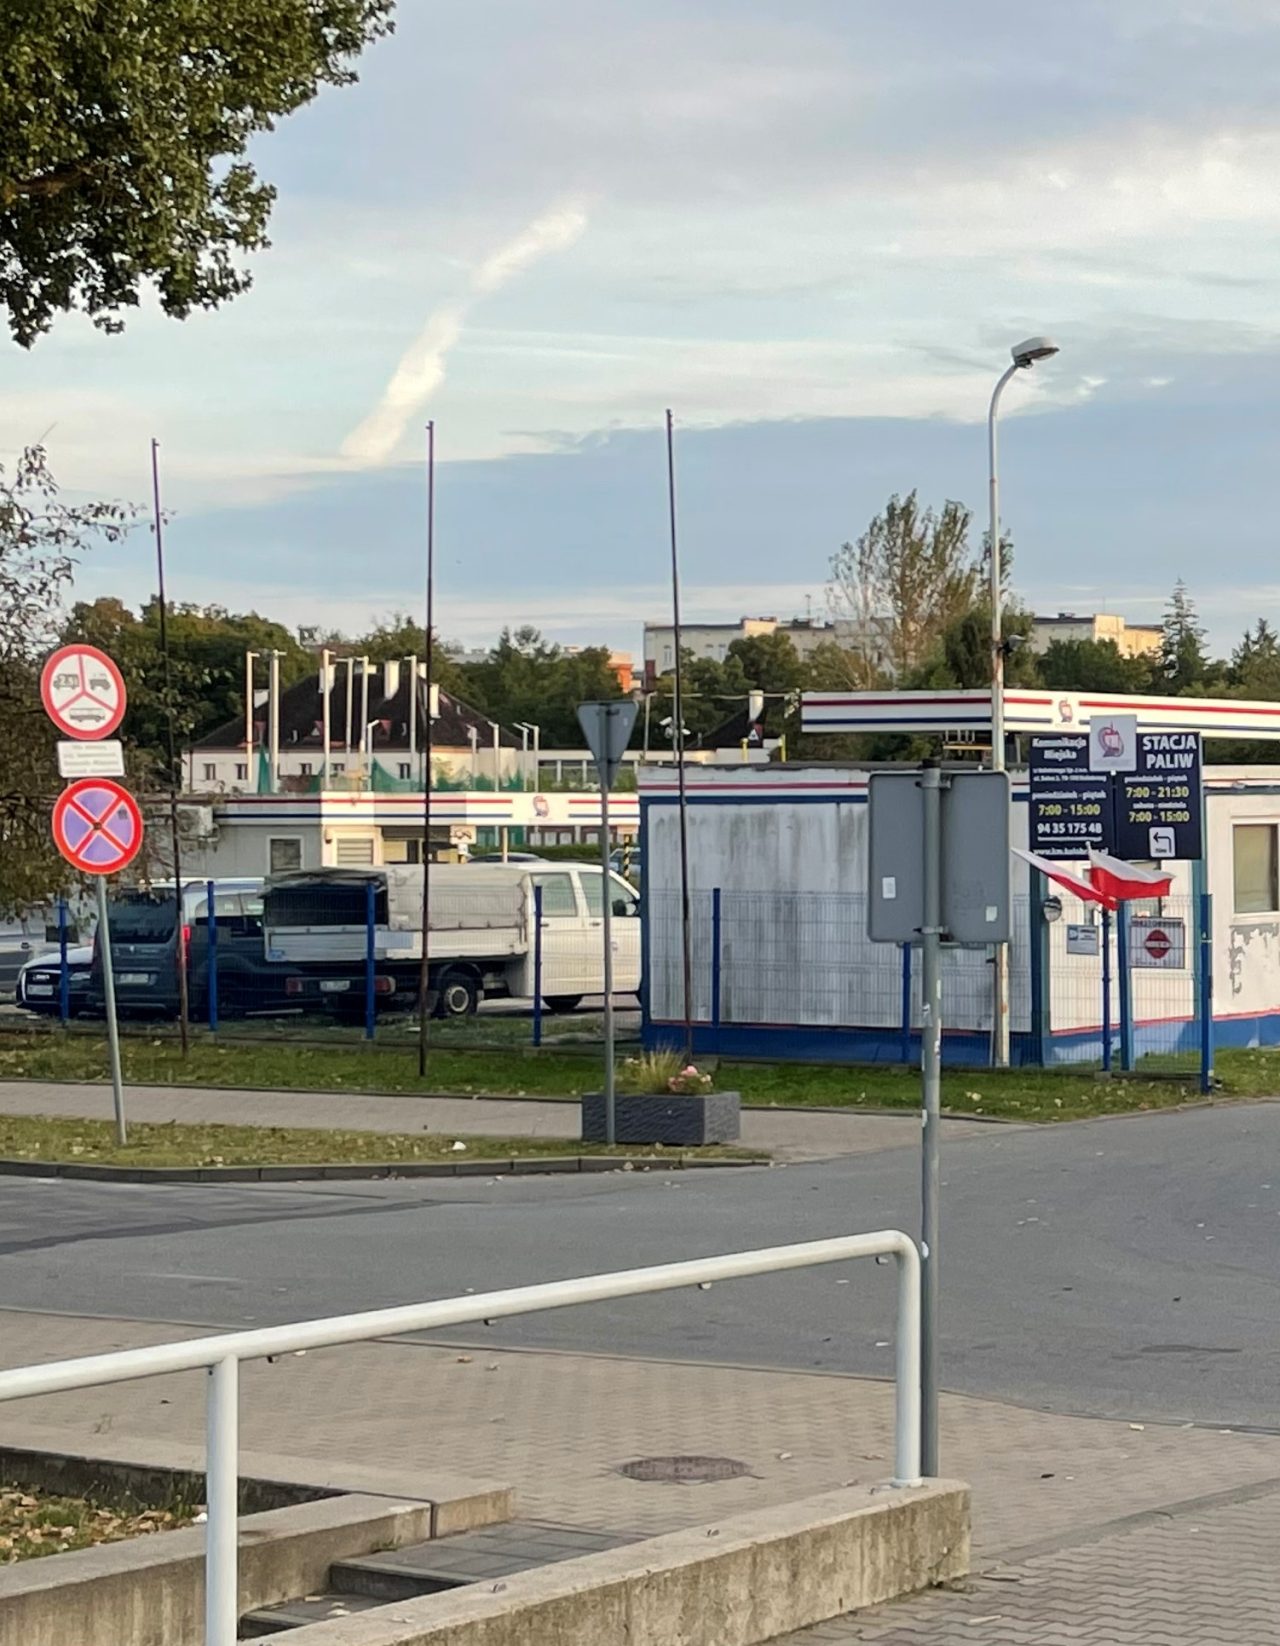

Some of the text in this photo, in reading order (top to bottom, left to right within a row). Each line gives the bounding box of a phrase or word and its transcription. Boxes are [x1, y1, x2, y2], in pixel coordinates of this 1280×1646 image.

[1142, 735, 1197, 751] STACJA
[1146, 753, 1194, 769] PALIW
[1125, 786, 1150, 798] 7:00
[1157, 786, 1190, 798] 21:30
[1038, 804, 1062, 816] 7:00
[1070, 804, 1101, 815] 15:00
[1128, 811, 1152, 823] 7:00
[1160, 811, 1190, 822] 15:00
[1037, 823, 1050, 834] 94
[1052, 823, 1066, 834] 35
[1067, 823, 1087, 834] 175
